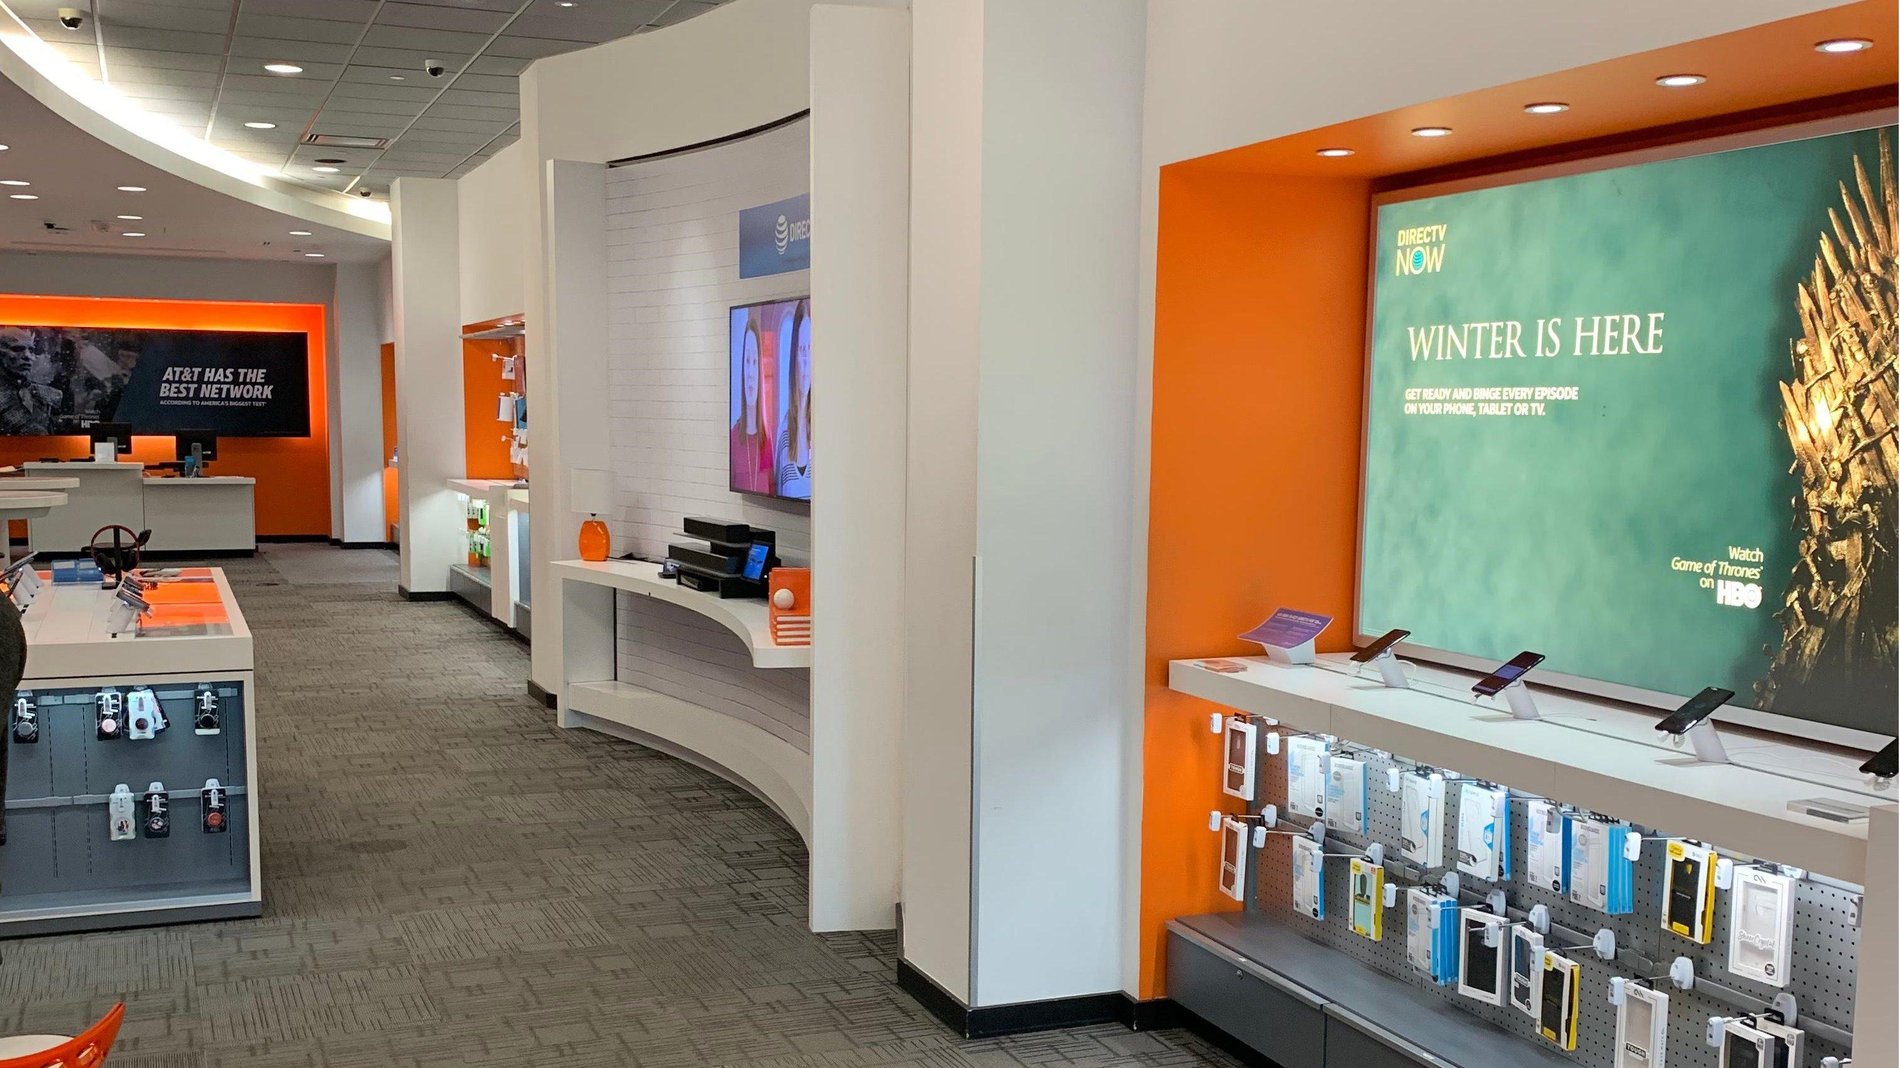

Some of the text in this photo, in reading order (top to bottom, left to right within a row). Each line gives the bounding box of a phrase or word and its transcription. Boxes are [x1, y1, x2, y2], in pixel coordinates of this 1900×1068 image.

[1397, 224, 1447, 247] DIRECTV
[1395, 243, 1446, 277] NOW
[1407, 312, 1665, 361] WINTER IS HERE
[162, 367, 267, 382] AT&T HAS THE
[160, 383, 274, 399] BEST NETWORK
[1405, 387, 1579, 400] GET READY AND BINGE EVERY EPISODE
[1404, 403, 1546, 417] ON YOUR PHONE, TABLET OR TV.
[1728, 545, 1764, 563] Watch
[1671, 556, 1763, 580] Game of Thrones
[1699, 577, 1763, 609] on HBO
